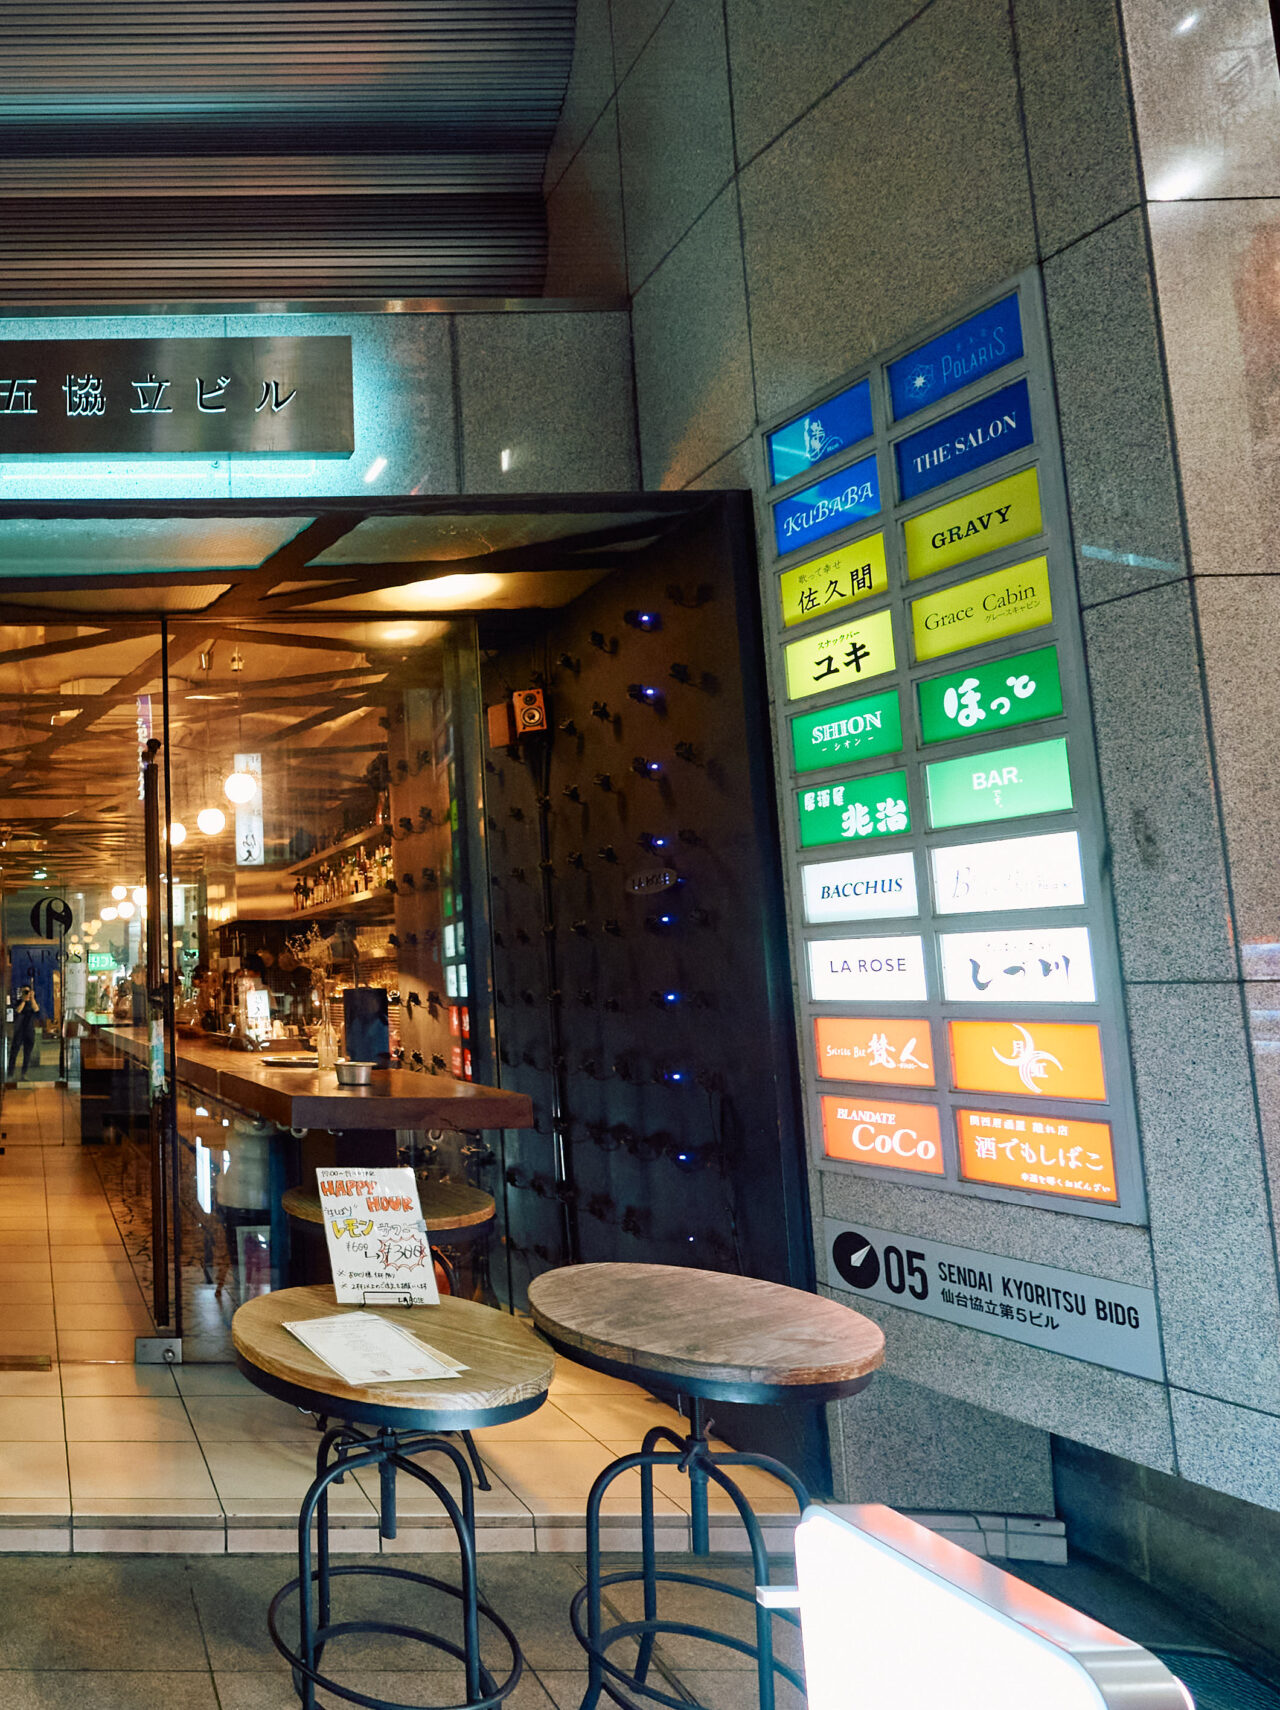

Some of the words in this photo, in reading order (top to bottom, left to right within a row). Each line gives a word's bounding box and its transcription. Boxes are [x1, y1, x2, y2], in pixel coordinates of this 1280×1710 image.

[913, 445, 951, 474] THE
[955, 412, 1018, 454] SALON
[783, 482, 873, 537] KUBABA
[931, 505, 1012, 550] GRAVY
[798, 560, 842, 585] 歌って幸せ
[798, 563, 873, 615] 佐久間
[924, 606, 974, 631] Grace
[982, 584, 1036, 612] Cabin
[985, 600, 1040, 623] グレースキャビン
[817, 630, 860, 650] スナックバー
[812, 641, 870, 682] ユキ
[943, 674, 1036, 727] ほっと
[811, 710, 882, 745] SHION
[820, 877, 903, 900] BACCHUS
[830, 959, 851, 974] LA
[858, 957, 907, 973] ROSE
[837, 1107, 896, 1125] BLANDATE
[851, 1123, 936, 1160] CoCo
[974, 1135, 1104, 1171] 酒でもしばこ
[320, 1180, 377, 1197] HAPPY
[366, 1195, 414, 1213] HOUR
[331, 1218, 374, 1239] レモン
[884, 1245, 929, 1300] 05
[938, 1261, 993, 1293] SENDAI
[1002, 1276, 1086, 1316] KYORITSU
[941, 1287, 1060, 1331] 仙台協立第5ビル
